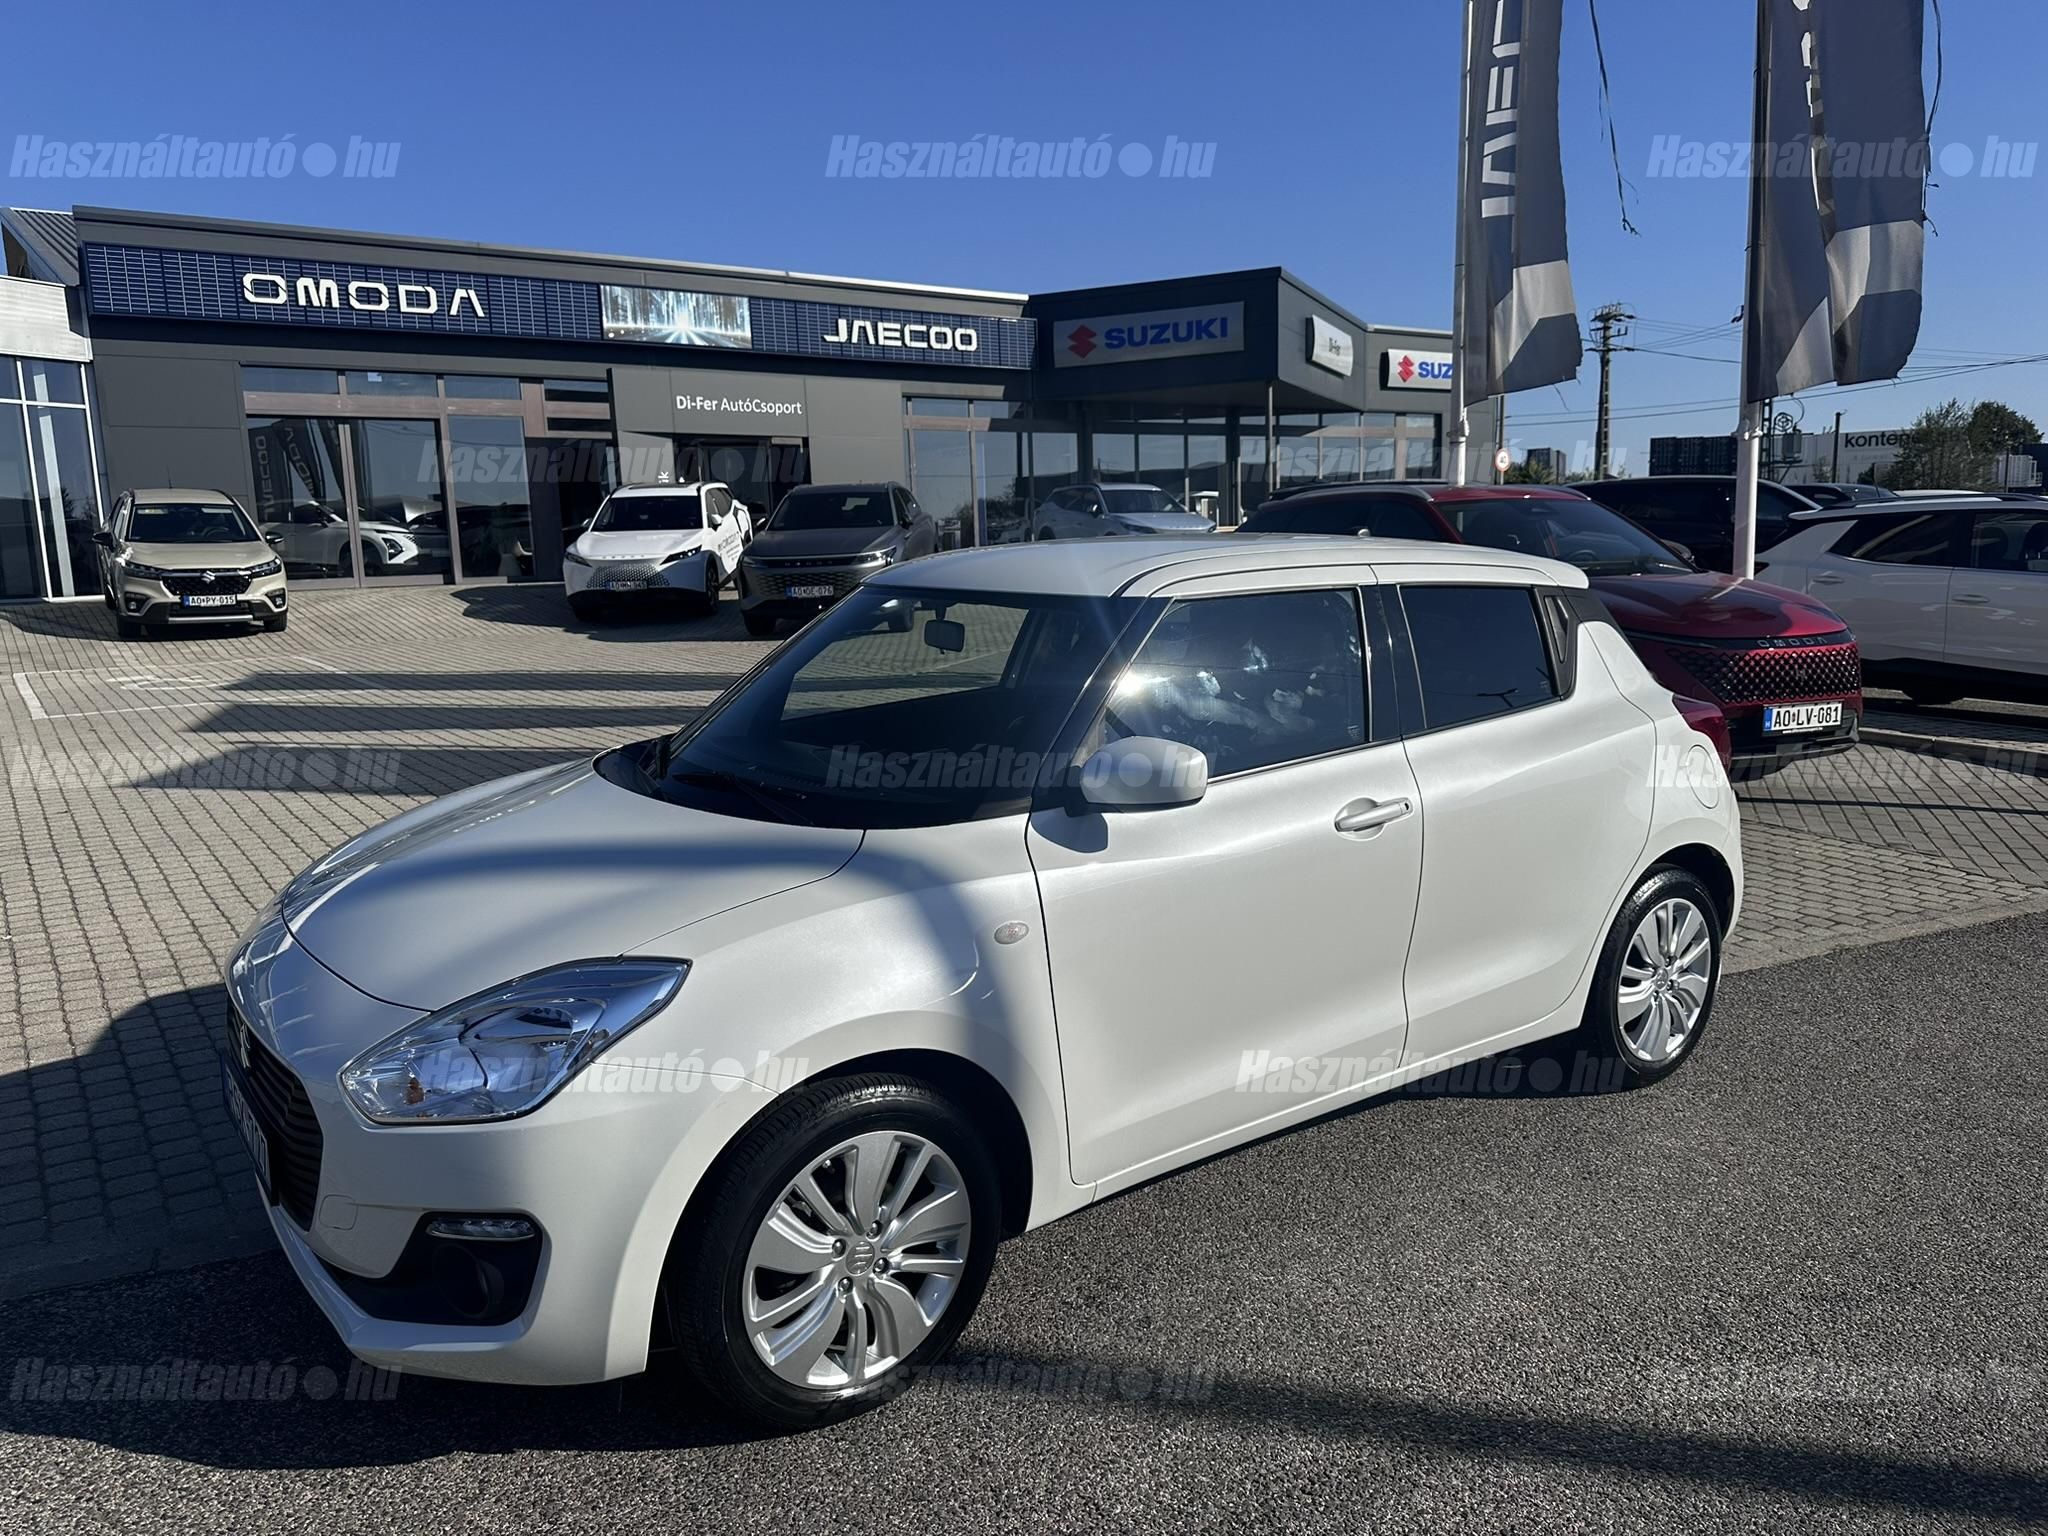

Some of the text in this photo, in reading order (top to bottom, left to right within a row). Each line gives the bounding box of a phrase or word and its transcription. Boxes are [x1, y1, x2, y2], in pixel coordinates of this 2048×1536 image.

[242, 272, 485, 318] OMODA
[823, 318, 978, 352] JAECOO
[1104, 316, 1228, 351] SUZUKI
[675, 395, 803, 416] Di-Fer AutóCsoport
